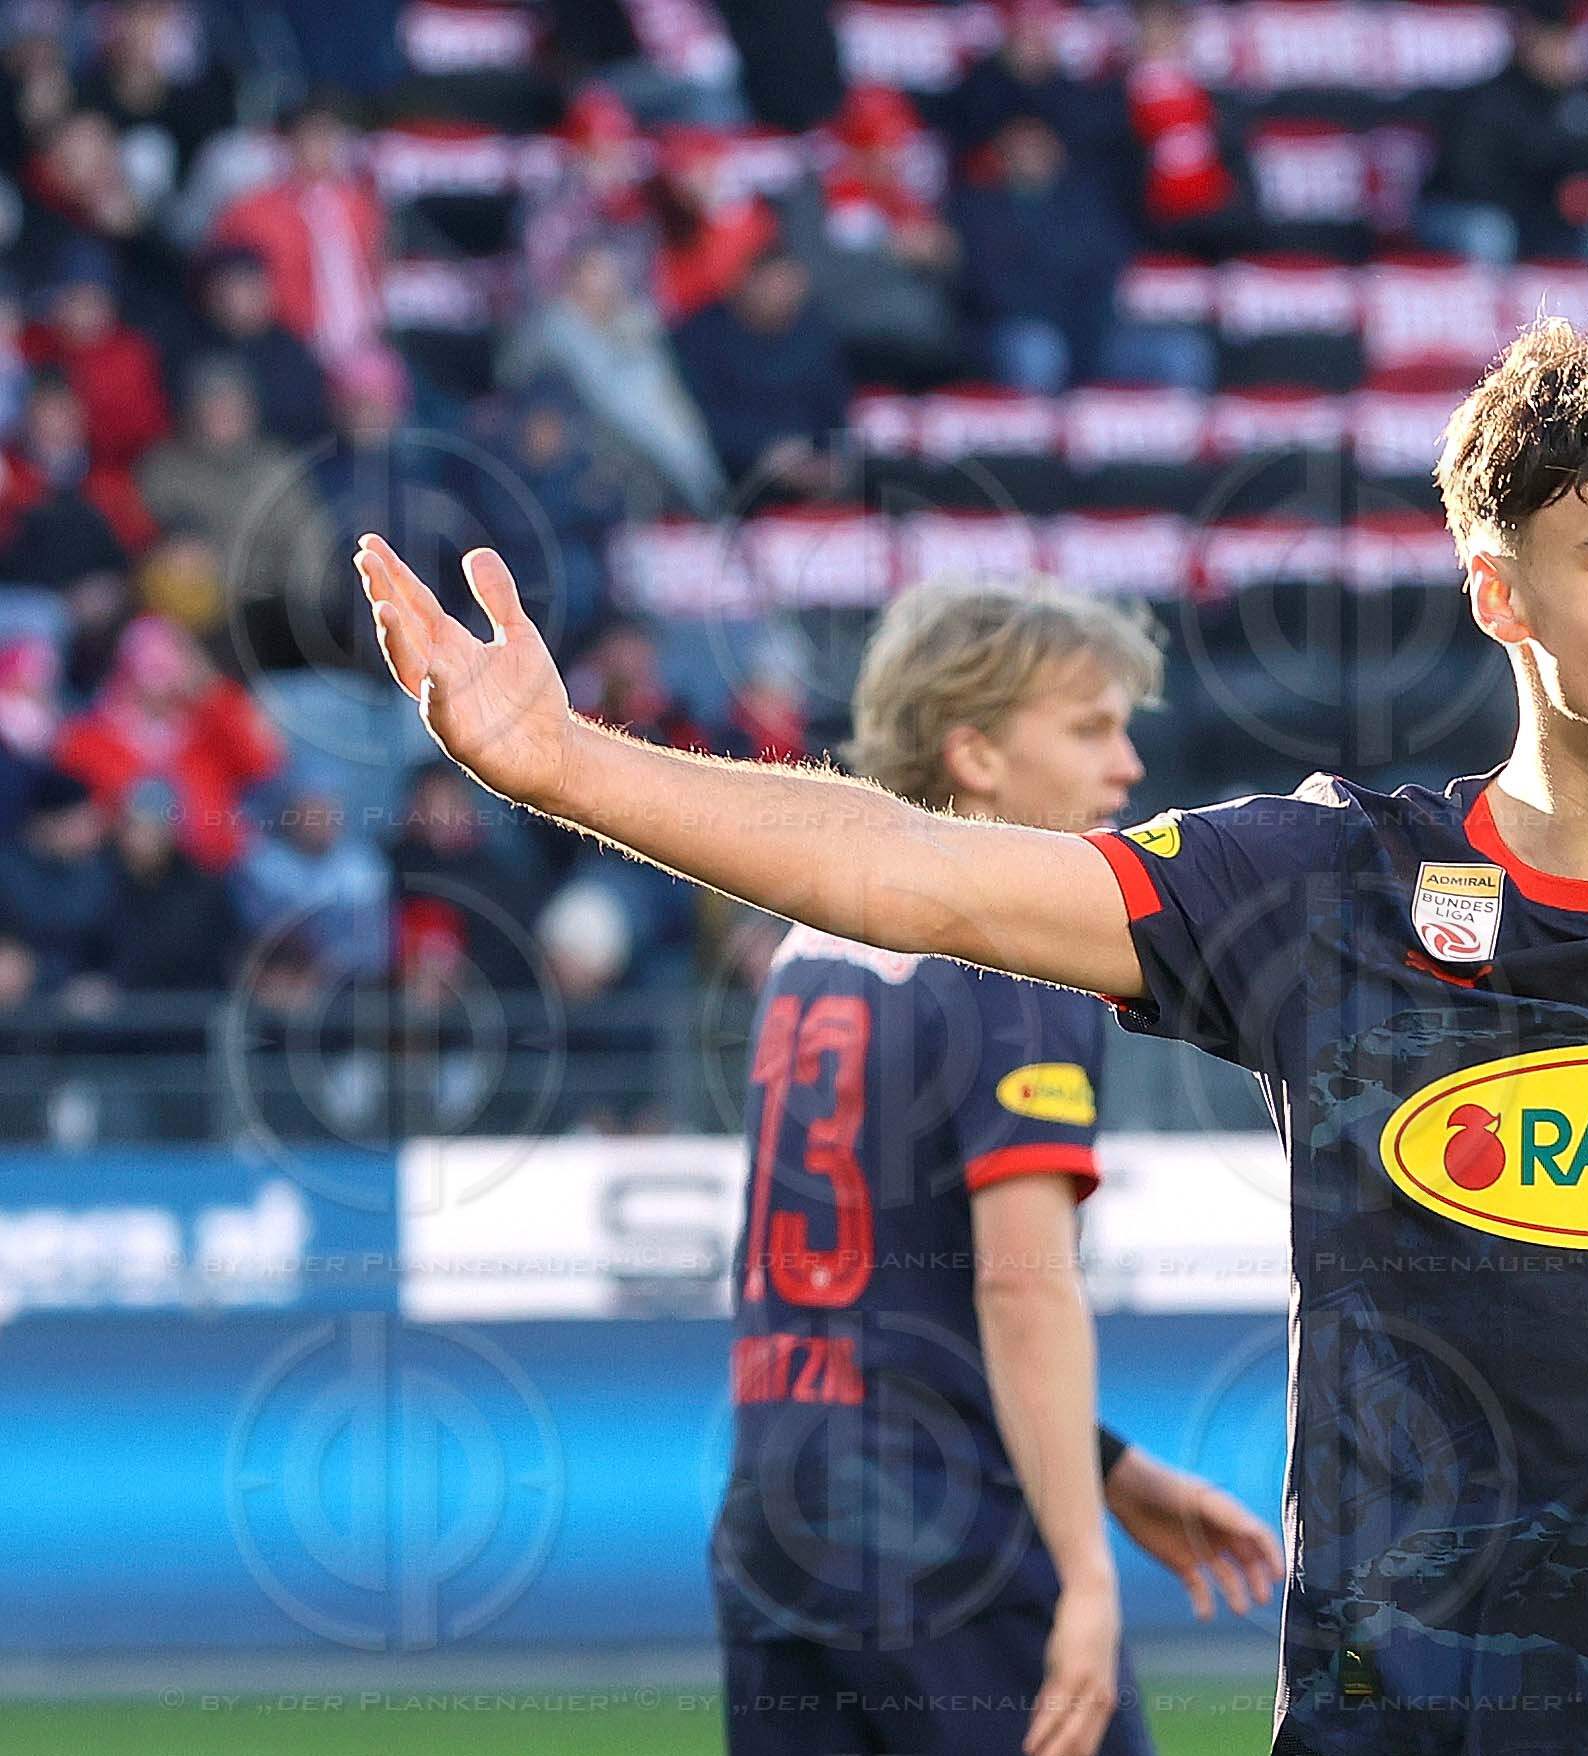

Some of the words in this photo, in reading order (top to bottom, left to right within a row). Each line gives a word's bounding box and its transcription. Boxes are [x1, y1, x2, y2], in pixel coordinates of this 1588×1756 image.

[1426, 873, 1497, 888] ADMIRAL
[1422, 892, 1495, 914] BUNDES
[1435, 906, 1475, 923] LIGA
